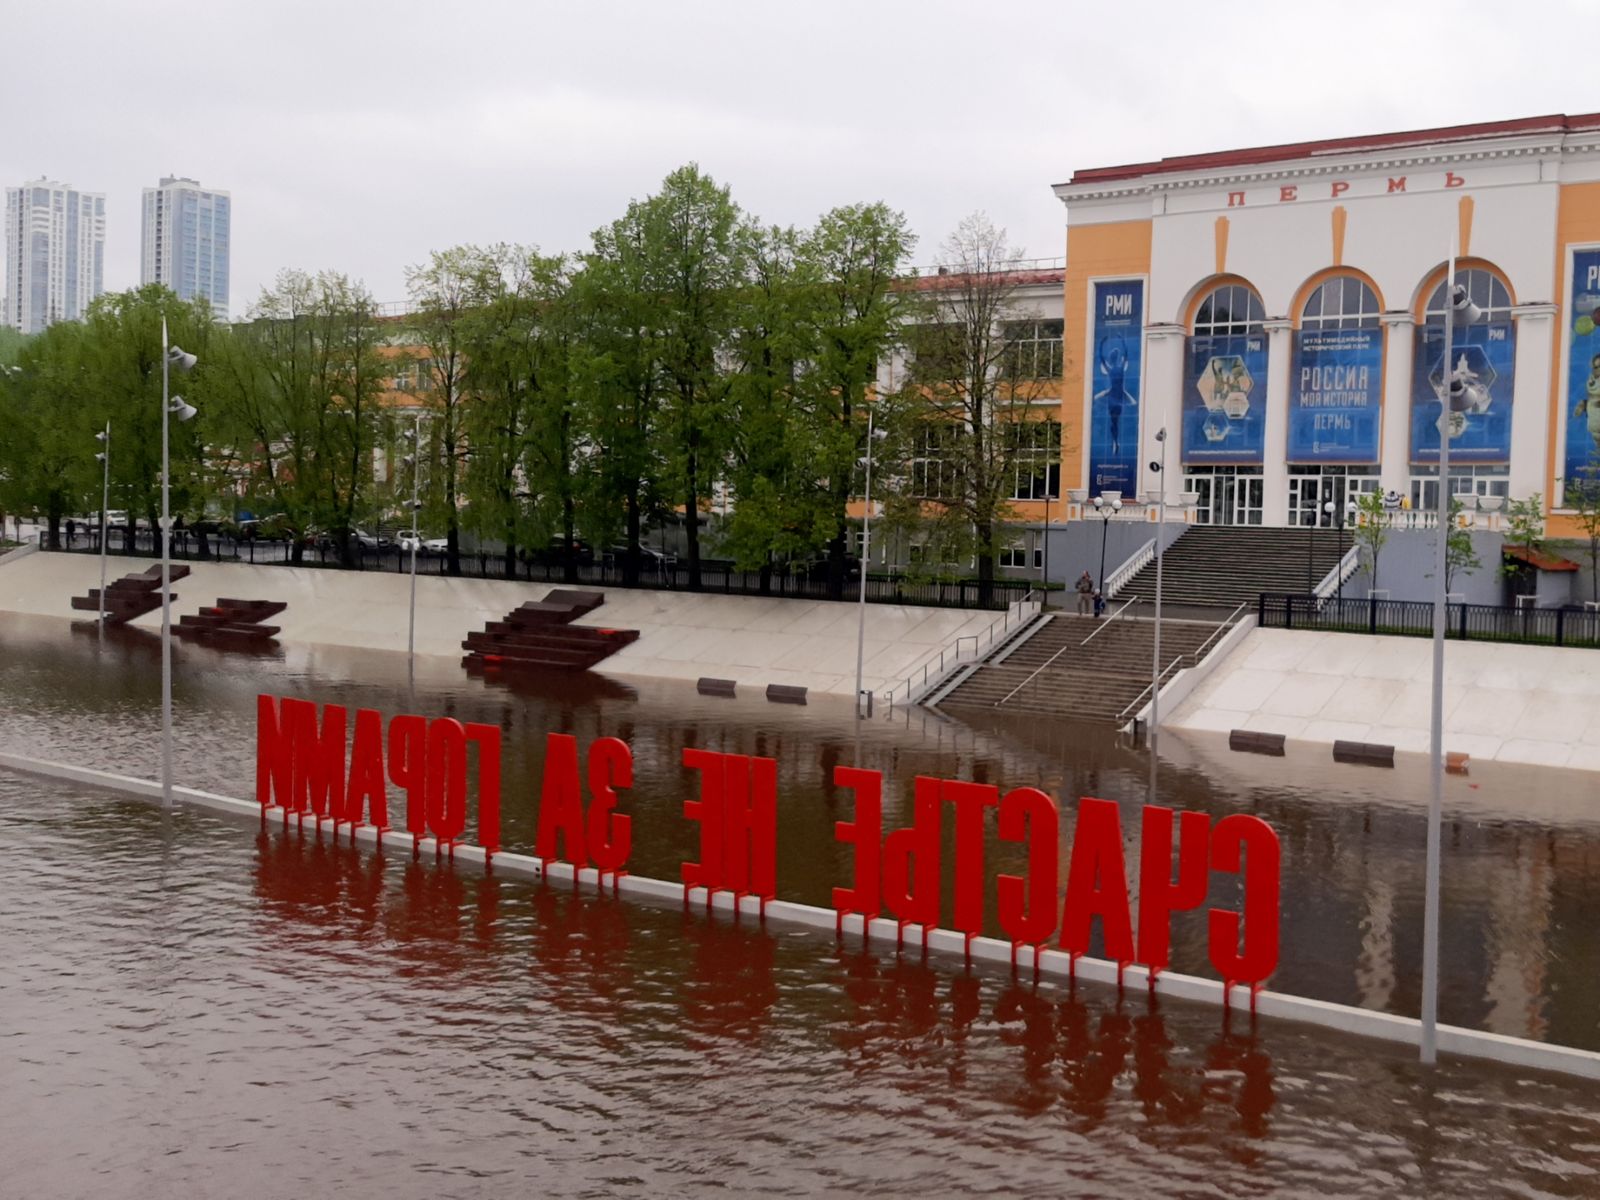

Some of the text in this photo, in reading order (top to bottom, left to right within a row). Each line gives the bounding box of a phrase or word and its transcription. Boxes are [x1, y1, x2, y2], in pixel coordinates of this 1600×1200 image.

[1228, 171, 1465, 207] ПЕРМЬ
[1105, 293, 1132, 316] РМИ
[1301, 366, 1369, 391] РОССИЯ
[1300, 391, 1368, 409] МОЯ ИСТОРИЯ
[1314, 413, 1351, 430] ПЕРМЬ
